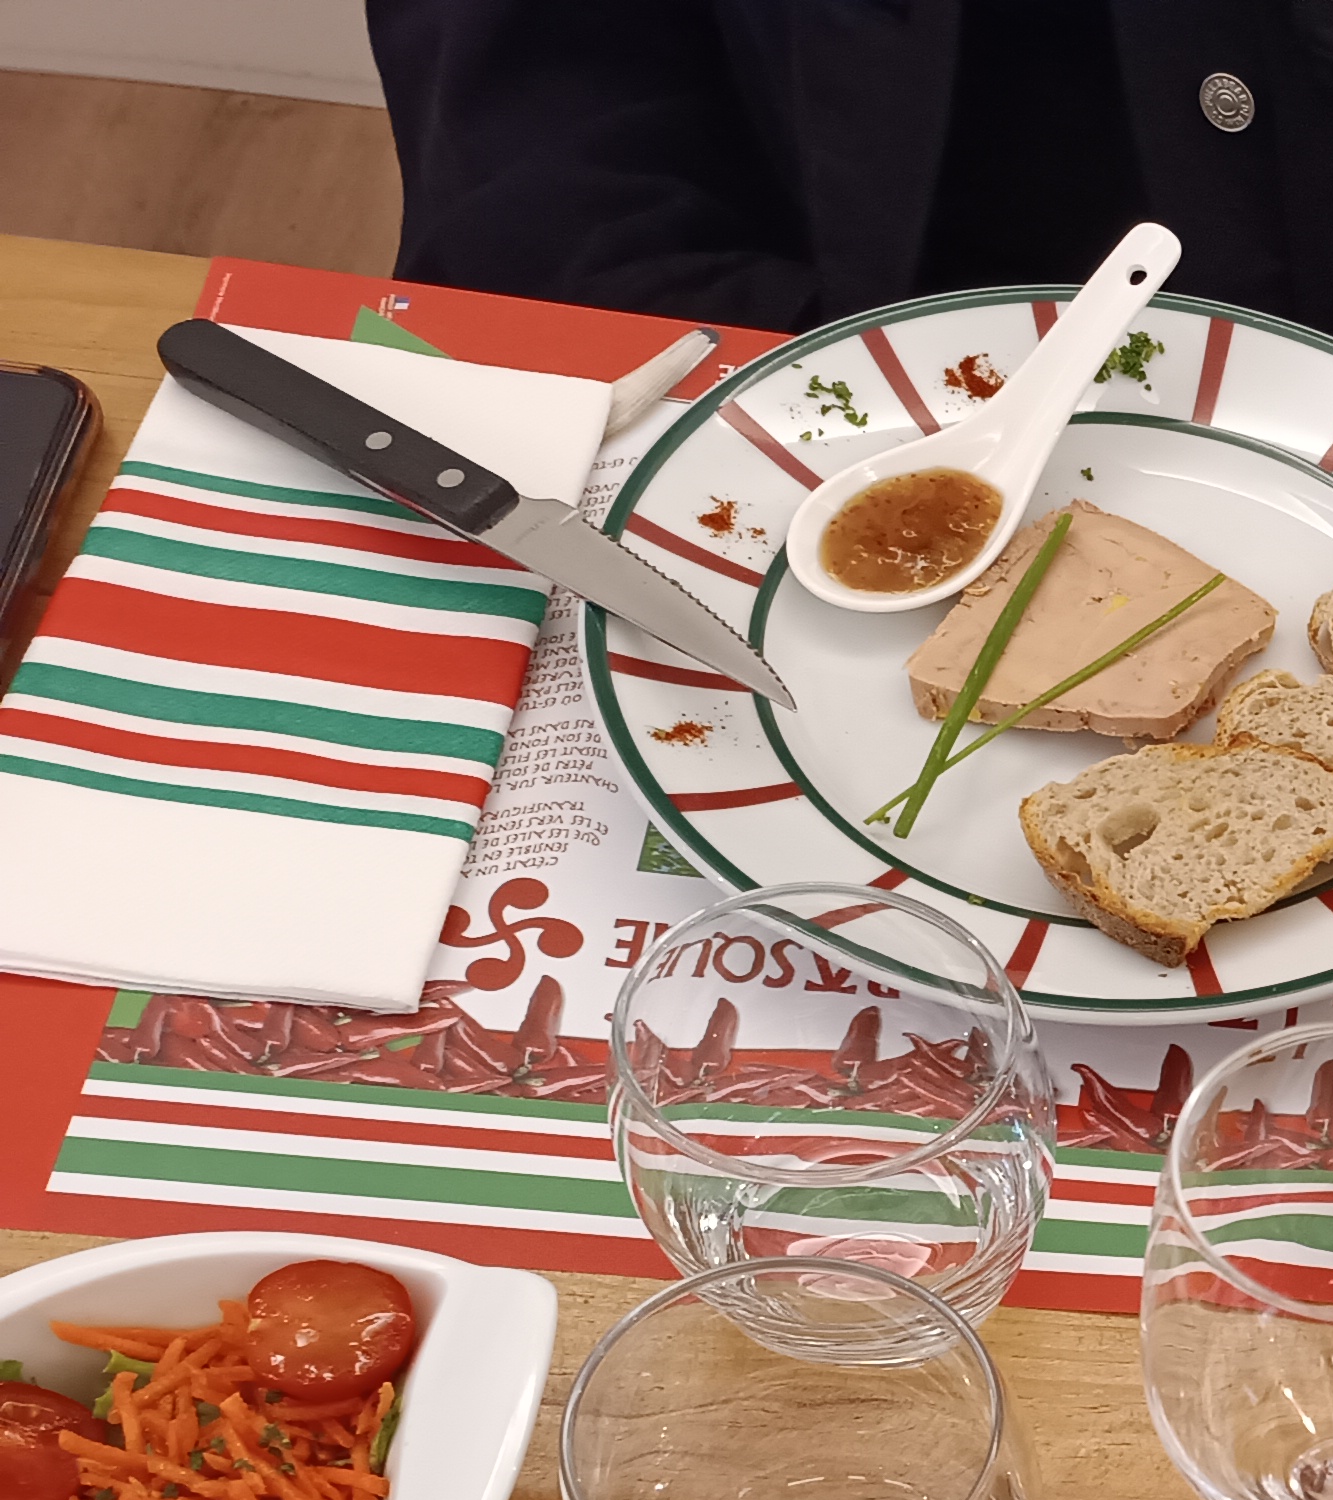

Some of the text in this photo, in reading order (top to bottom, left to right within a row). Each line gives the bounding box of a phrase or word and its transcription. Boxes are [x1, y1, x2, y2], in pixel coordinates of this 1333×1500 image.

[530, 720, 570, 735] DANS
[508, 732, 602, 752] DE SON FOND
[534, 748, 557, 761] LES
[532, 762, 551, 774] DE
[506, 773, 619, 794] CHANTEUR SUR
[526, 814, 564, 828] VERS
[571, 815, 592, 828] LES
[595, 821, 609, 836] ET
[481, 828, 601, 849] QUE LES AILES DE
[482, 850, 502, 862] EN
[506, 842, 569, 858] SENSIBLE
[475, 865, 499, 877] UN
